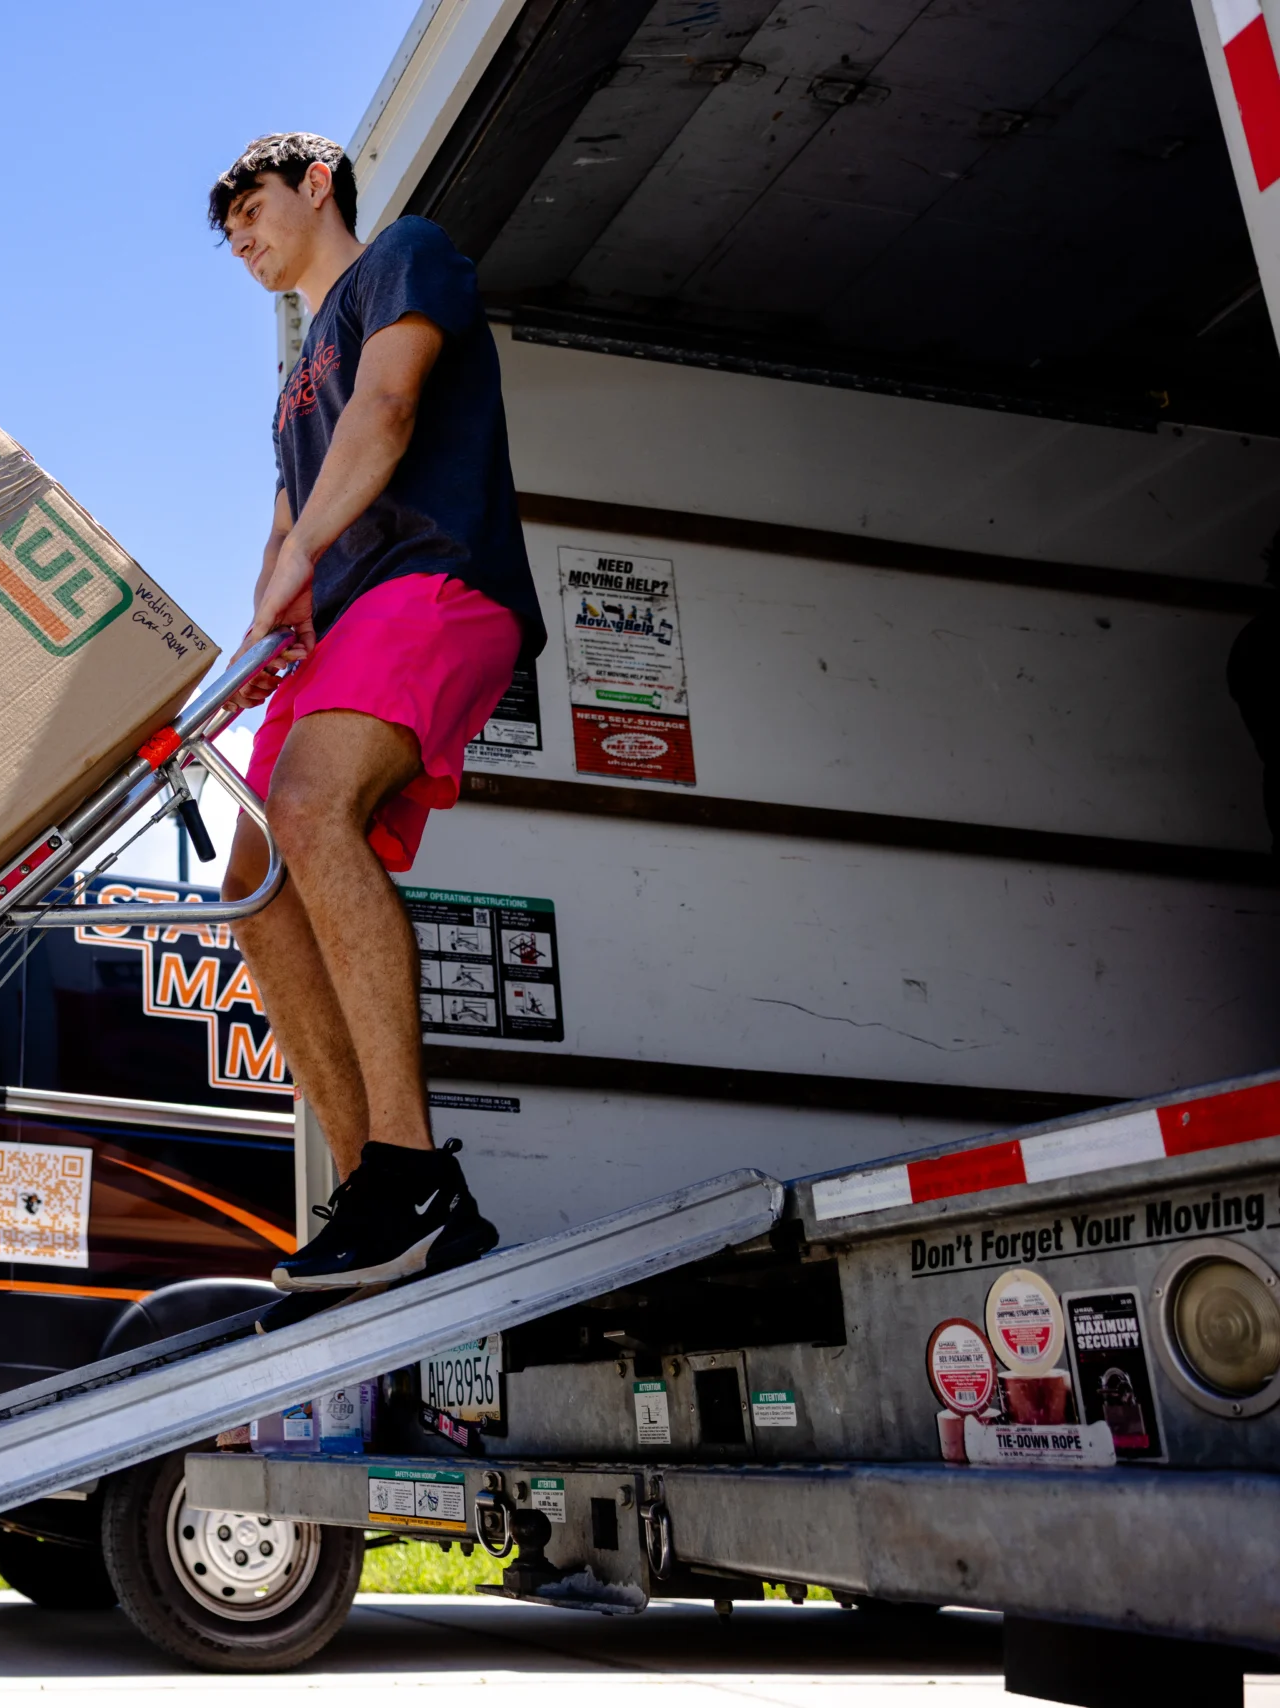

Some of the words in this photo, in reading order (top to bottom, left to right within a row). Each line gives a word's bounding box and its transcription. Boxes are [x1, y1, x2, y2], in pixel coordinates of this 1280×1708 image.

[597, 557, 633, 574] NEED
[568, 570, 623, 590] MOVING
[626, 577, 669, 594] HELP?
[135, 583, 174, 627] Wedding
[576, 711, 605, 721] NEED
[608, 715, 686, 730] SELF-STORAGE
[405, 890, 428, 898] RAMP
[429, 893, 472, 904] OPERATING
[473, 897, 528, 908] INSTRUCTIONS
[911, 1234, 973, 1271] Don't
[981, 1219, 1063, 1263] Forget
[1071, 1214, 1135, 1248] Your
[1145, 1192, 1265, 1239] Moving
[1074, 1317, 1138, 1335] MAXIMUM
[1077, 1331, 1139, 1349] SECURITY
[972, 1354, 984, 1362] TAPE
[428, 1355, 494, 1410] AH28956
[759, 1392, 787, 1402] ATTENTION
[326, 1404, 354, 1414] ZERO
[996, 1434, 1049, 1449] TIE-DOWN
[1051, 1435, 1082, 1449] ROPE
